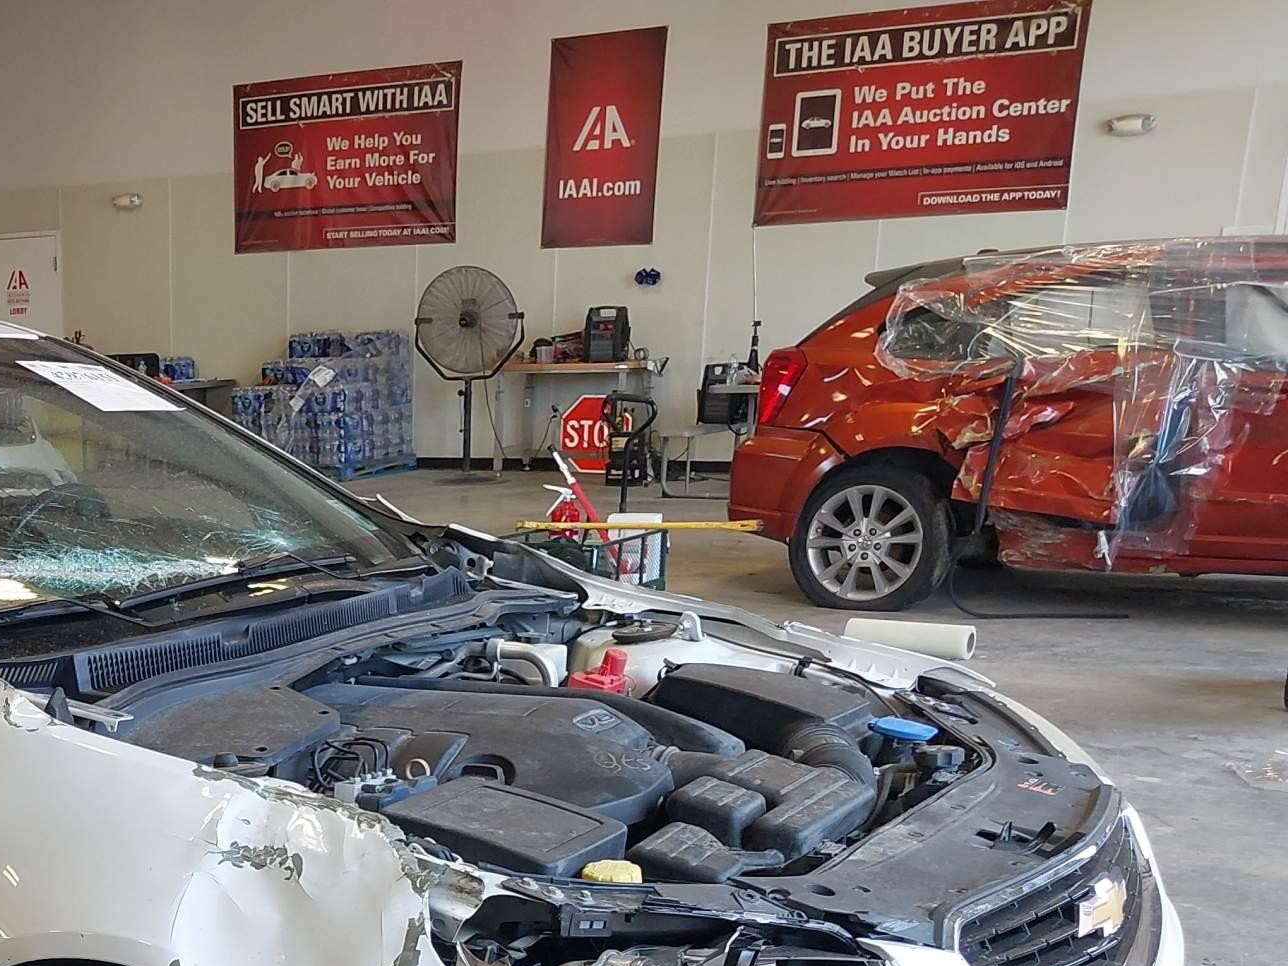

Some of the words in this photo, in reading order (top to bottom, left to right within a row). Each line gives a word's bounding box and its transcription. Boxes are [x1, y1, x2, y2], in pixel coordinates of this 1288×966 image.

[785, 39, 836, 70] THE
[844, 33, 893, 64] IAA
[902, 23, 998, 58] BUYER
[1005, 15, 1068, 49] APP
[854, 86, 888, 104] We
[896, 82, 935, 101] Put
[943, 77, 986, 96] The
[246, 99, 285, 124] SELL
[289, 91, 354, 118] SMART
[358, 87, 408, 112] WITH
[414, 84, 448, 107] IAA
[852, 110, 892, 128] IAA
[898, 104, 986, 126] Auction
[992, 97, 1071, 118] Center
[327, 136, 350, 151] We
[354, 133, 388, 152] Help
[393, 131, 422, 147] You
[849, 136, 870, 153] In
[879, 132, 929, 151] Your
[937, 126, 1010, 146] Hands
[327, 154, 361, 171] Earn
[365, 152, 404, 168] More
[408, 149, 435, 165] For
[327, 174, 360, 190] Your
[364, 169, 421, 187] Vehicle
[558, 178, 641, 200] IAAI.com
[923, 194, 980, 206] DOWNLOAD
[981, 192, 1000, 202] THE
[1002, 191, 1023, 201] APP
[1023, 189, 1061, 200] TODAY!
[378, 229, 401, 237] TODAY
[402, 228, 412, 236] AT
